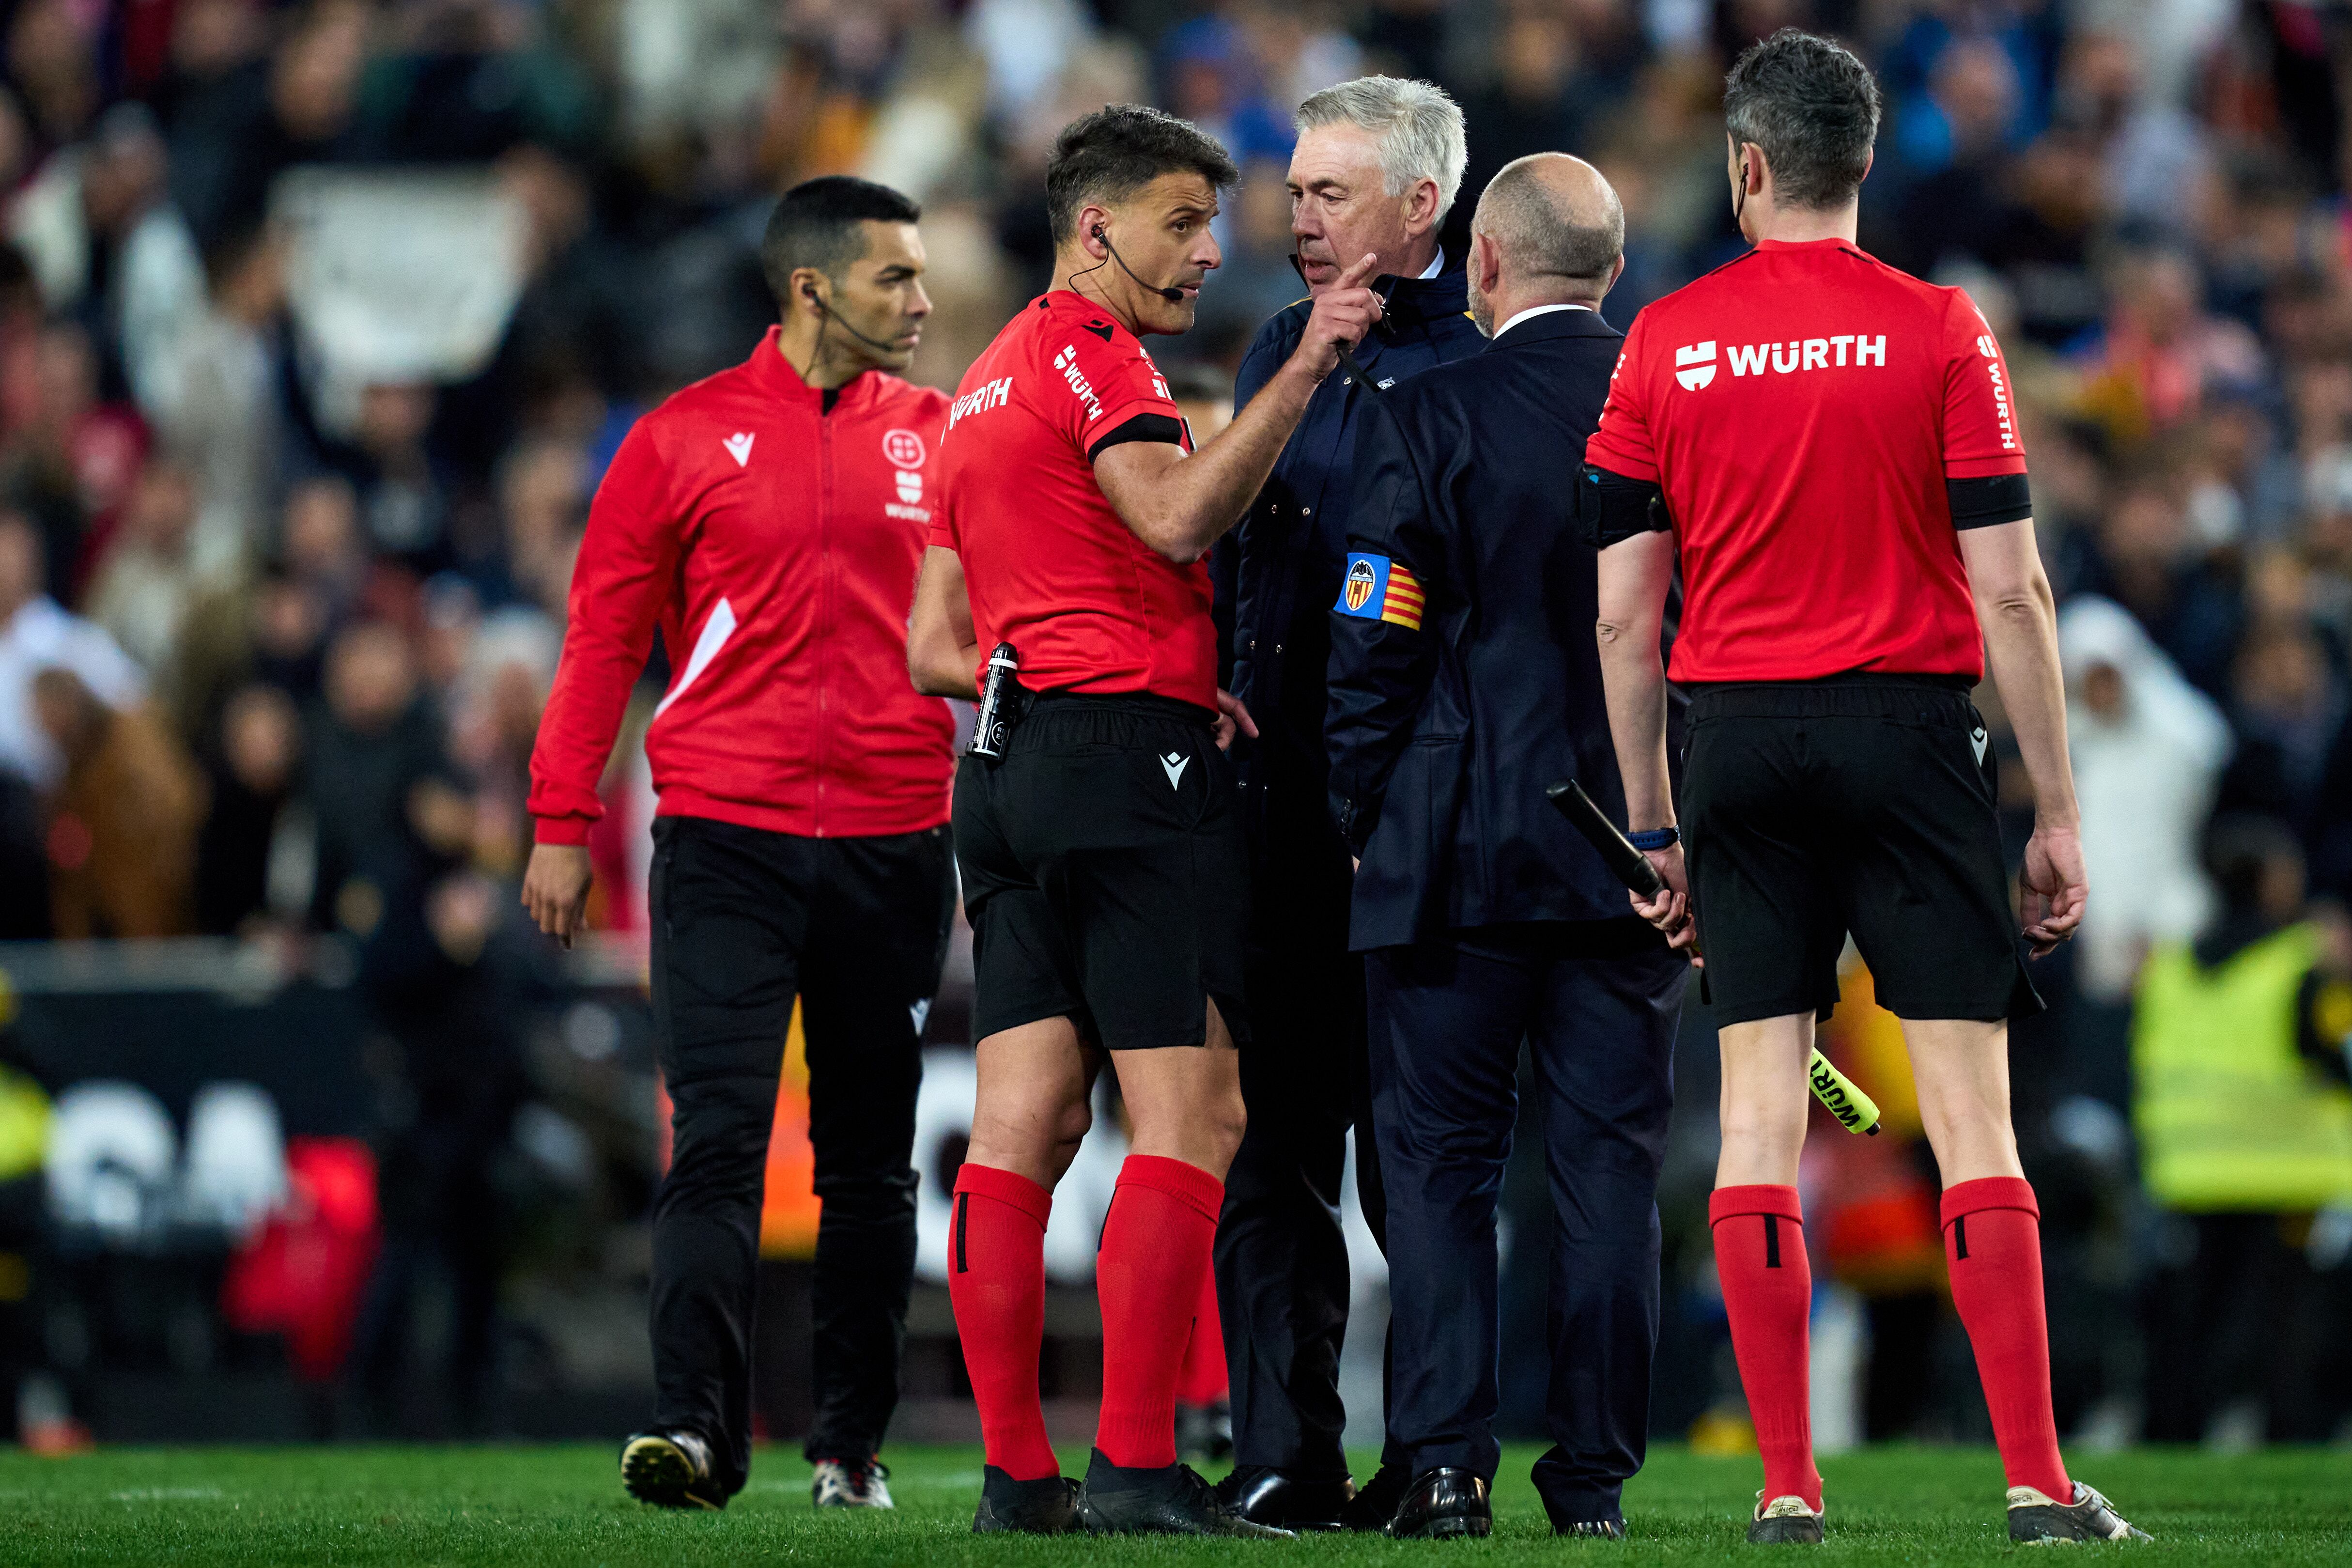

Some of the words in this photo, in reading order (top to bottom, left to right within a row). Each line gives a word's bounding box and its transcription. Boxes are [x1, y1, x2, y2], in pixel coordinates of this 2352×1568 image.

[1726, 335, 1887, 377] WÜRTH
[949, 377, 1013, 431] WÜRTH
[1988, 362, 2016, 449] WÜRTH
[1809, 1058, 1861, 1127] WÜRT
